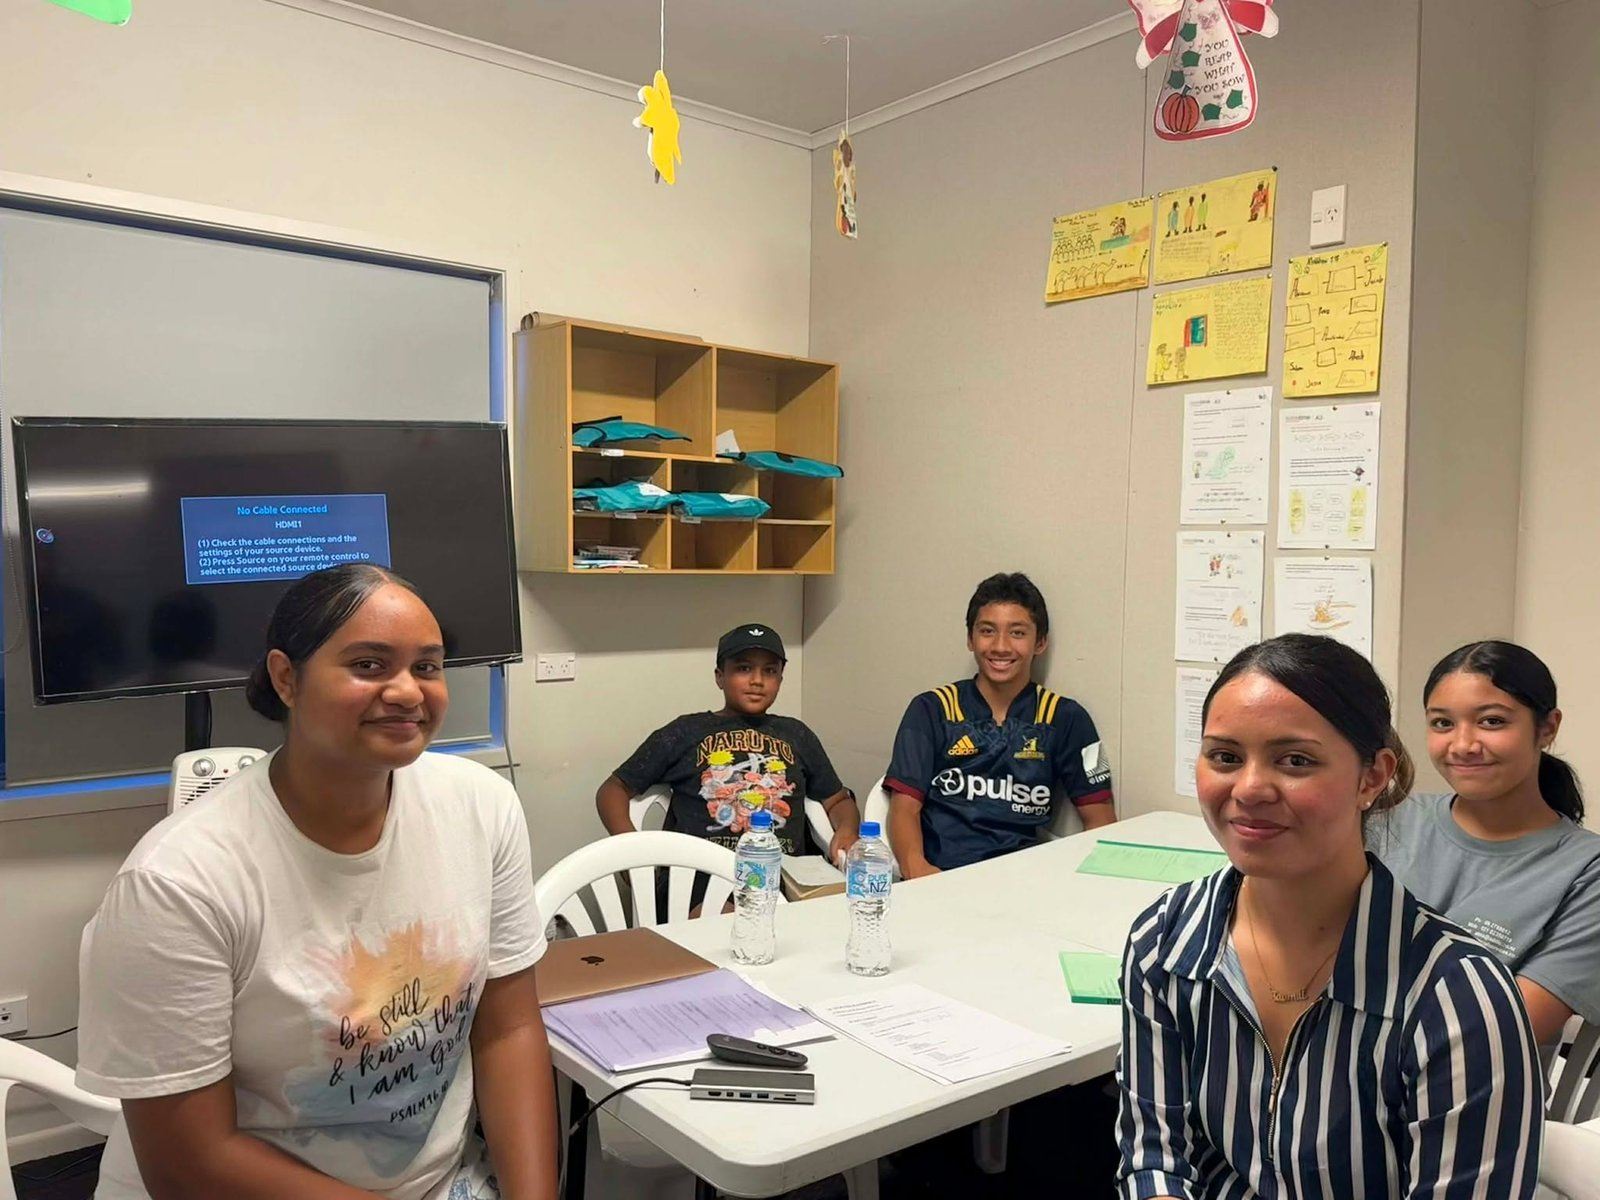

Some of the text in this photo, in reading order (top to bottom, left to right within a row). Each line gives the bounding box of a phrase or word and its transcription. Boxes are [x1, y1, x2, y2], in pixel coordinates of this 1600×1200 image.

[1205, 39, 1229, 52] YOU
[1205, 51, 1232, 66] REAP
[1204, 62, 1235, 79] WHAT
[1195, 74, 1245, 95] YOU SOW
[237, 504, 328, 515] No Cable Connected
[275, 520, 302, 529] HDMI1
[197, 534, 357, 548] (1) Check the cable connections and the
[198, 544, 323, 558] settings of your source device.
[199, 557, 211, 567] (2)
[212, 557, 235, 566] Press
[236, 556, 266, 565] Source
[279, 556, 299, 564] your
[300, 554, 330, 562] remote
[331, 552, 360, 561] control
[360, 551, 370, 560] to
[200, 567, 226, 576] select
[227, 566, 242, 574] the
[243, 564, 287, 574] connected
[287, 563, 316, 573] source
[696, 729, 794, 767] NARUTO
[966, 774, 1050, 806] pulse
[1011, 802, 1050, 816] energy
[870, 881, 887, 893] NZ
[340, 977, 430, 1050] be still
[329, 982, 475, 1086] & know that
[349, 1084, 355, 1105] I
[368, 1062, 419, 1100] am
[390, 1097, 426, 1123] PSALM
